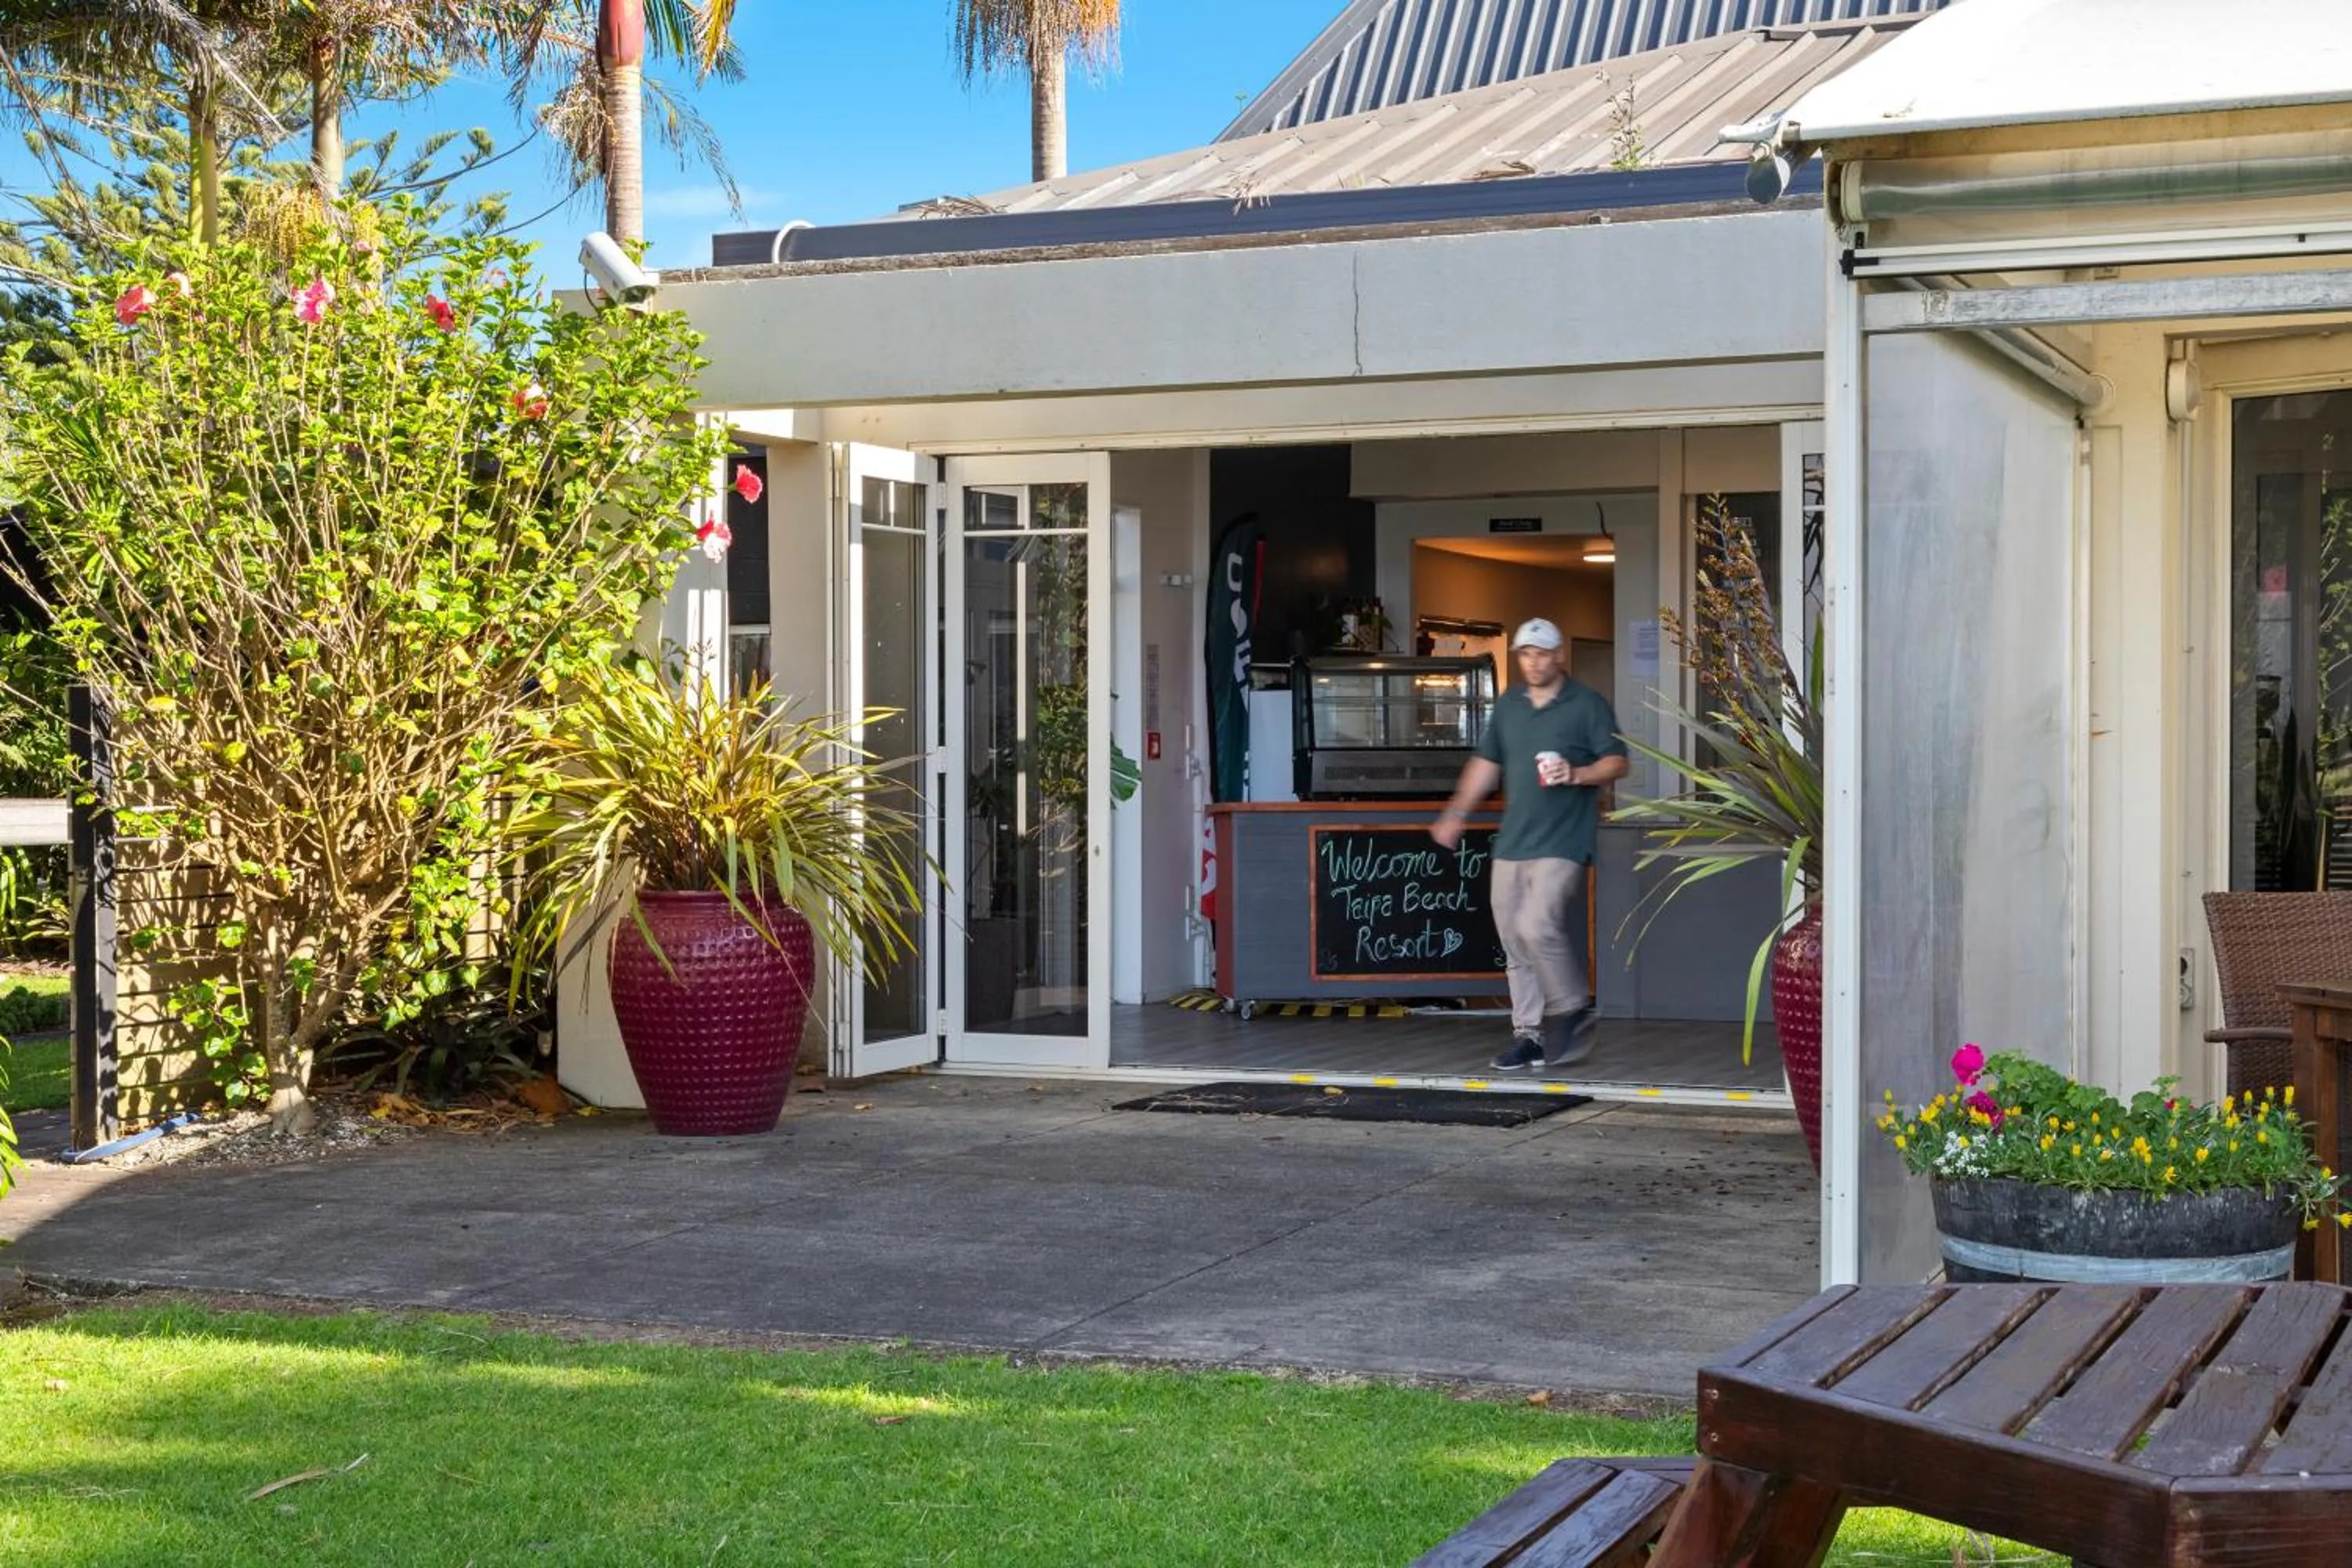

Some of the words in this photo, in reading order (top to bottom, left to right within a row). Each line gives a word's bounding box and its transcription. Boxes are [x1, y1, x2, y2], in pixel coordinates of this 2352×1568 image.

[1321, 837, 1443, 882] Welcome
[1454, 838, 1487, 879] to
[1331, 884, 1392, 924] Taipa
[1403, 881, 1477, 913] Beach
[1356, 918, 1441, 964] Resort
